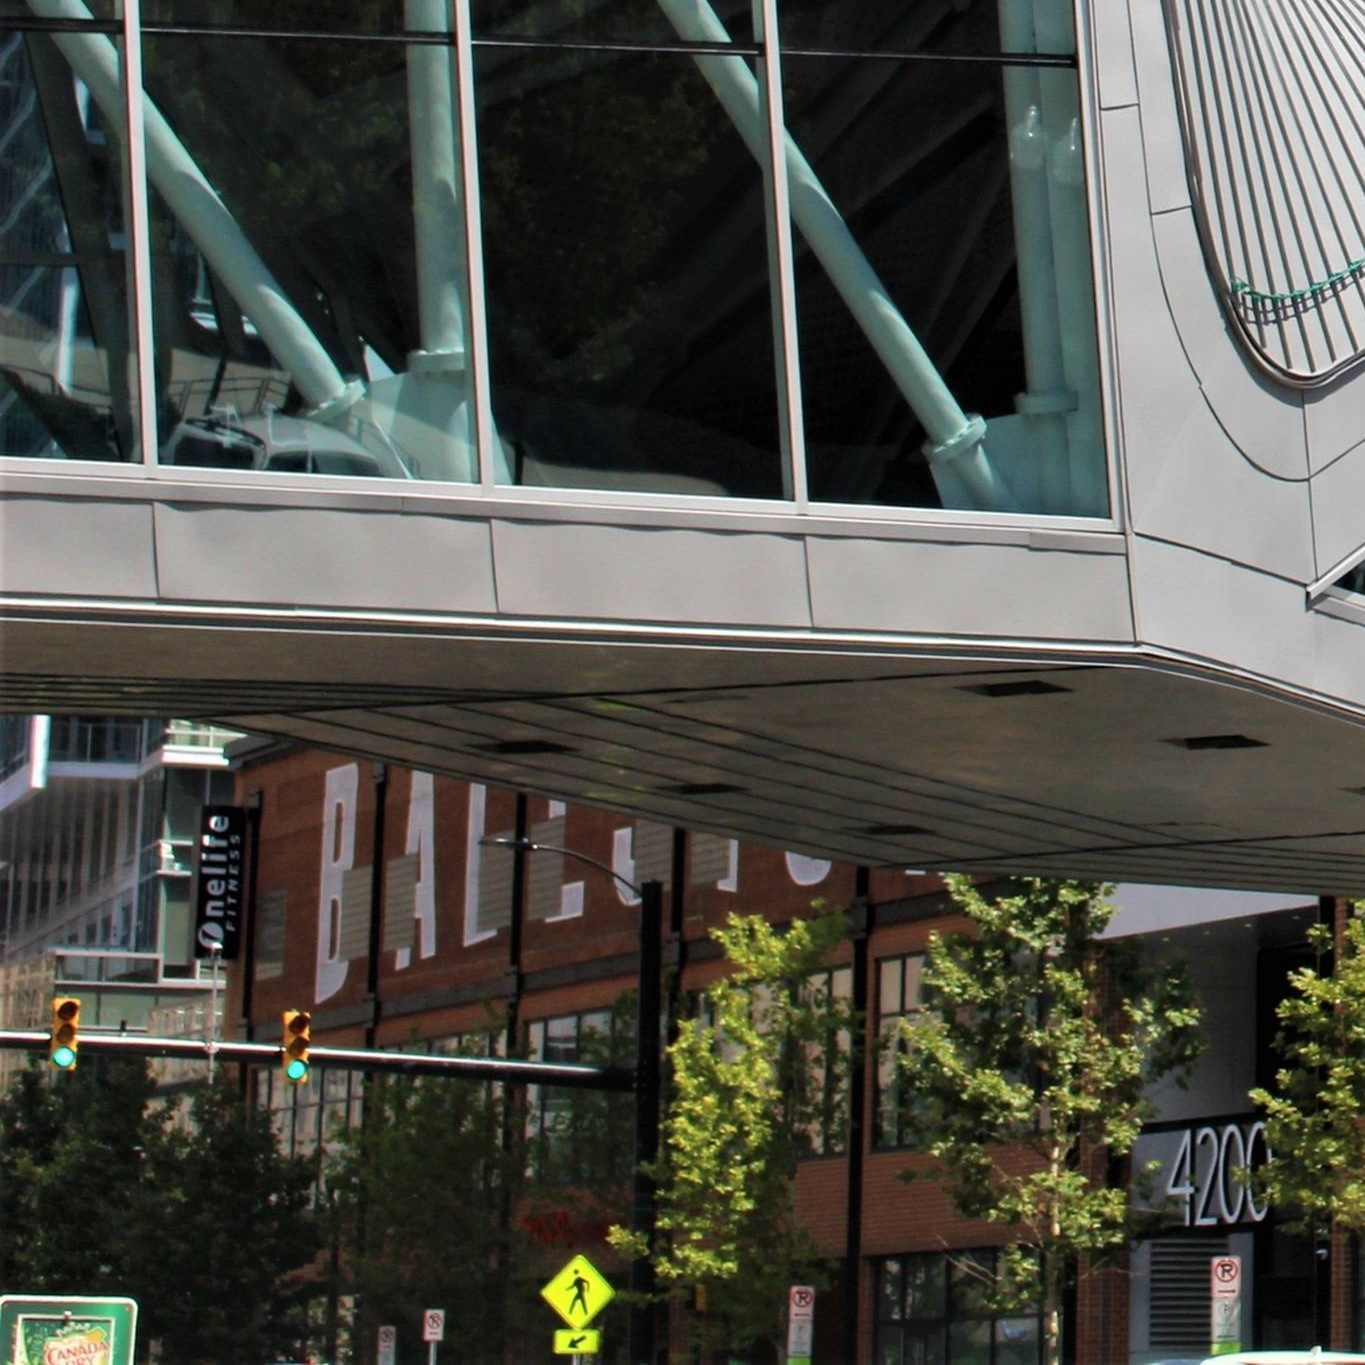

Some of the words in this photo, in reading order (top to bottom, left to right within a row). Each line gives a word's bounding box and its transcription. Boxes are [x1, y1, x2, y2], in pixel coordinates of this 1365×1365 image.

[226, 834, 241, 932] FITNESS
[1167, 1121, 1272, 1226] 4200
[47, 1340, 109, 1365] CANADA
